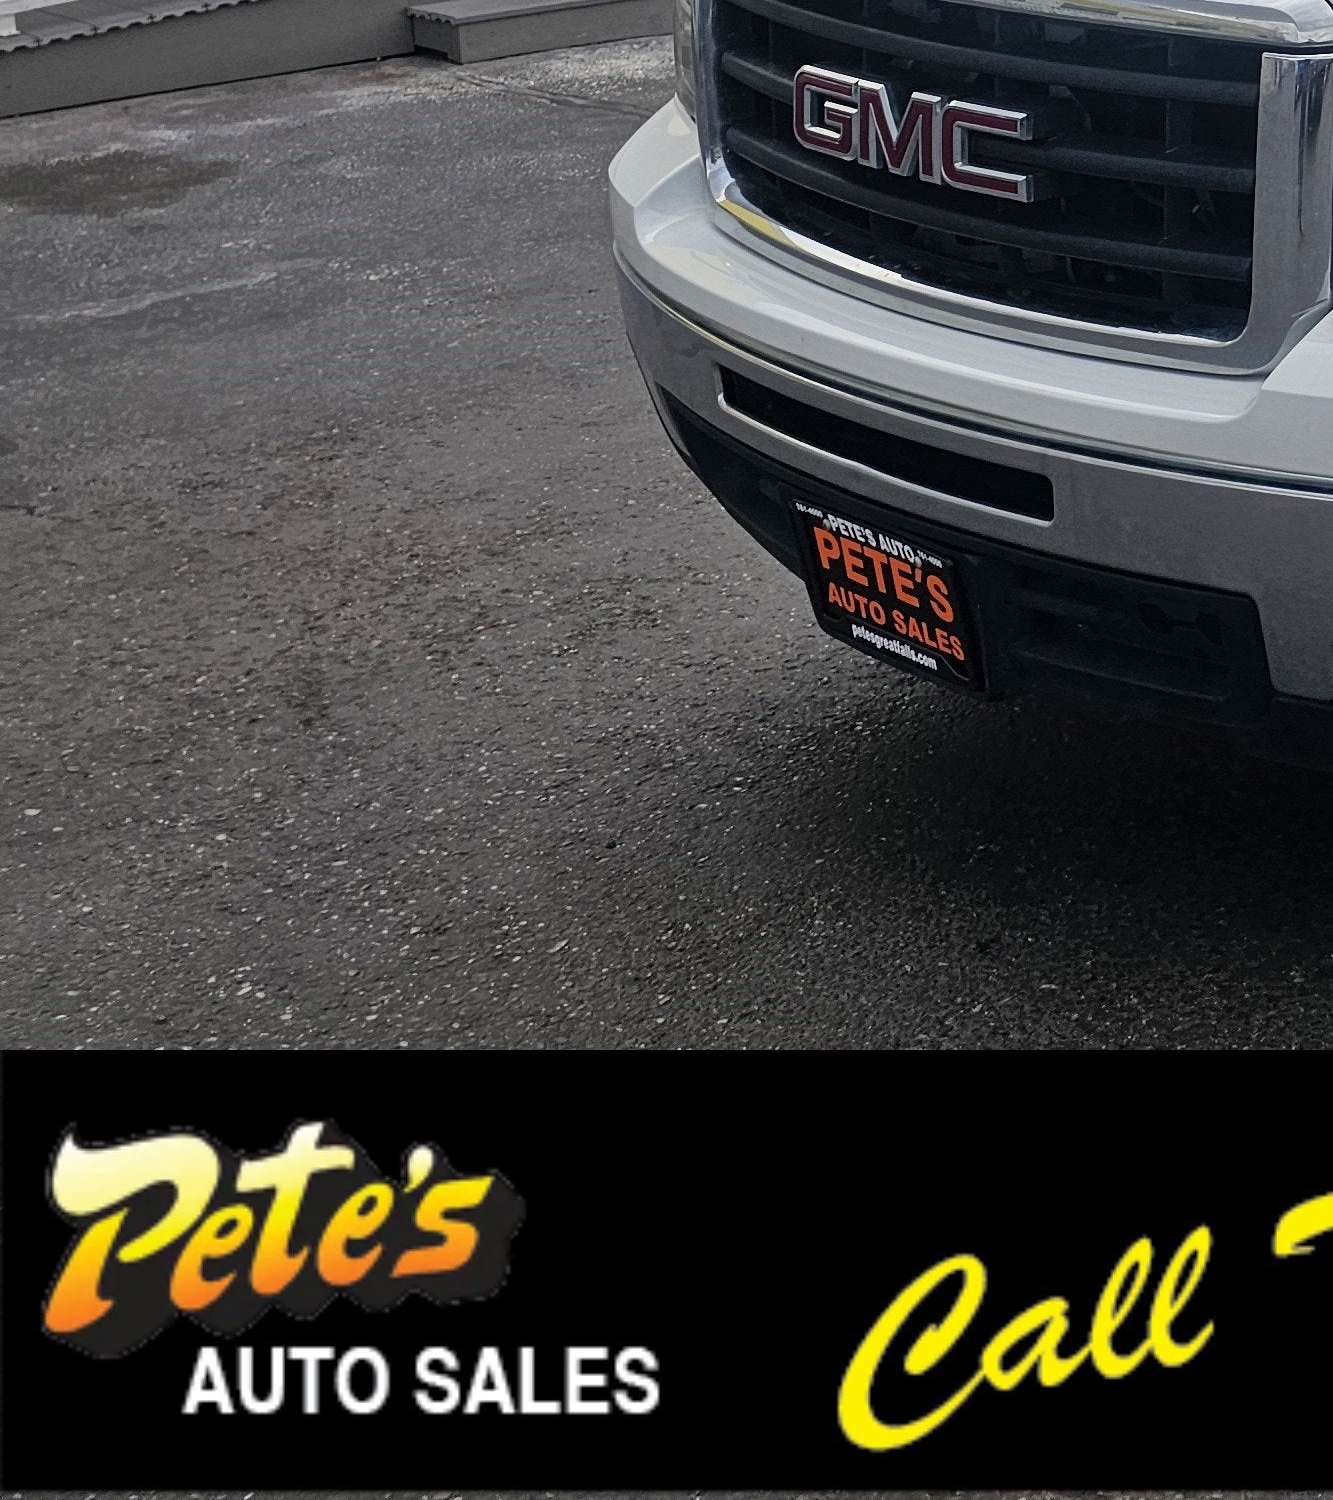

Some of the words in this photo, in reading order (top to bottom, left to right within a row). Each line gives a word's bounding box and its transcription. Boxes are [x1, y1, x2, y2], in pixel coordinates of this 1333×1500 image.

[793, 65, 1034, 203] GMC
[813, 526, 954, 623] PETE'S
[827, 513, 877, 547] PETE'S
[878, 533, 915, 564] AUTO
[828, 581, 886, 626] AUTO
[892, 609, 965, 661] SALES
